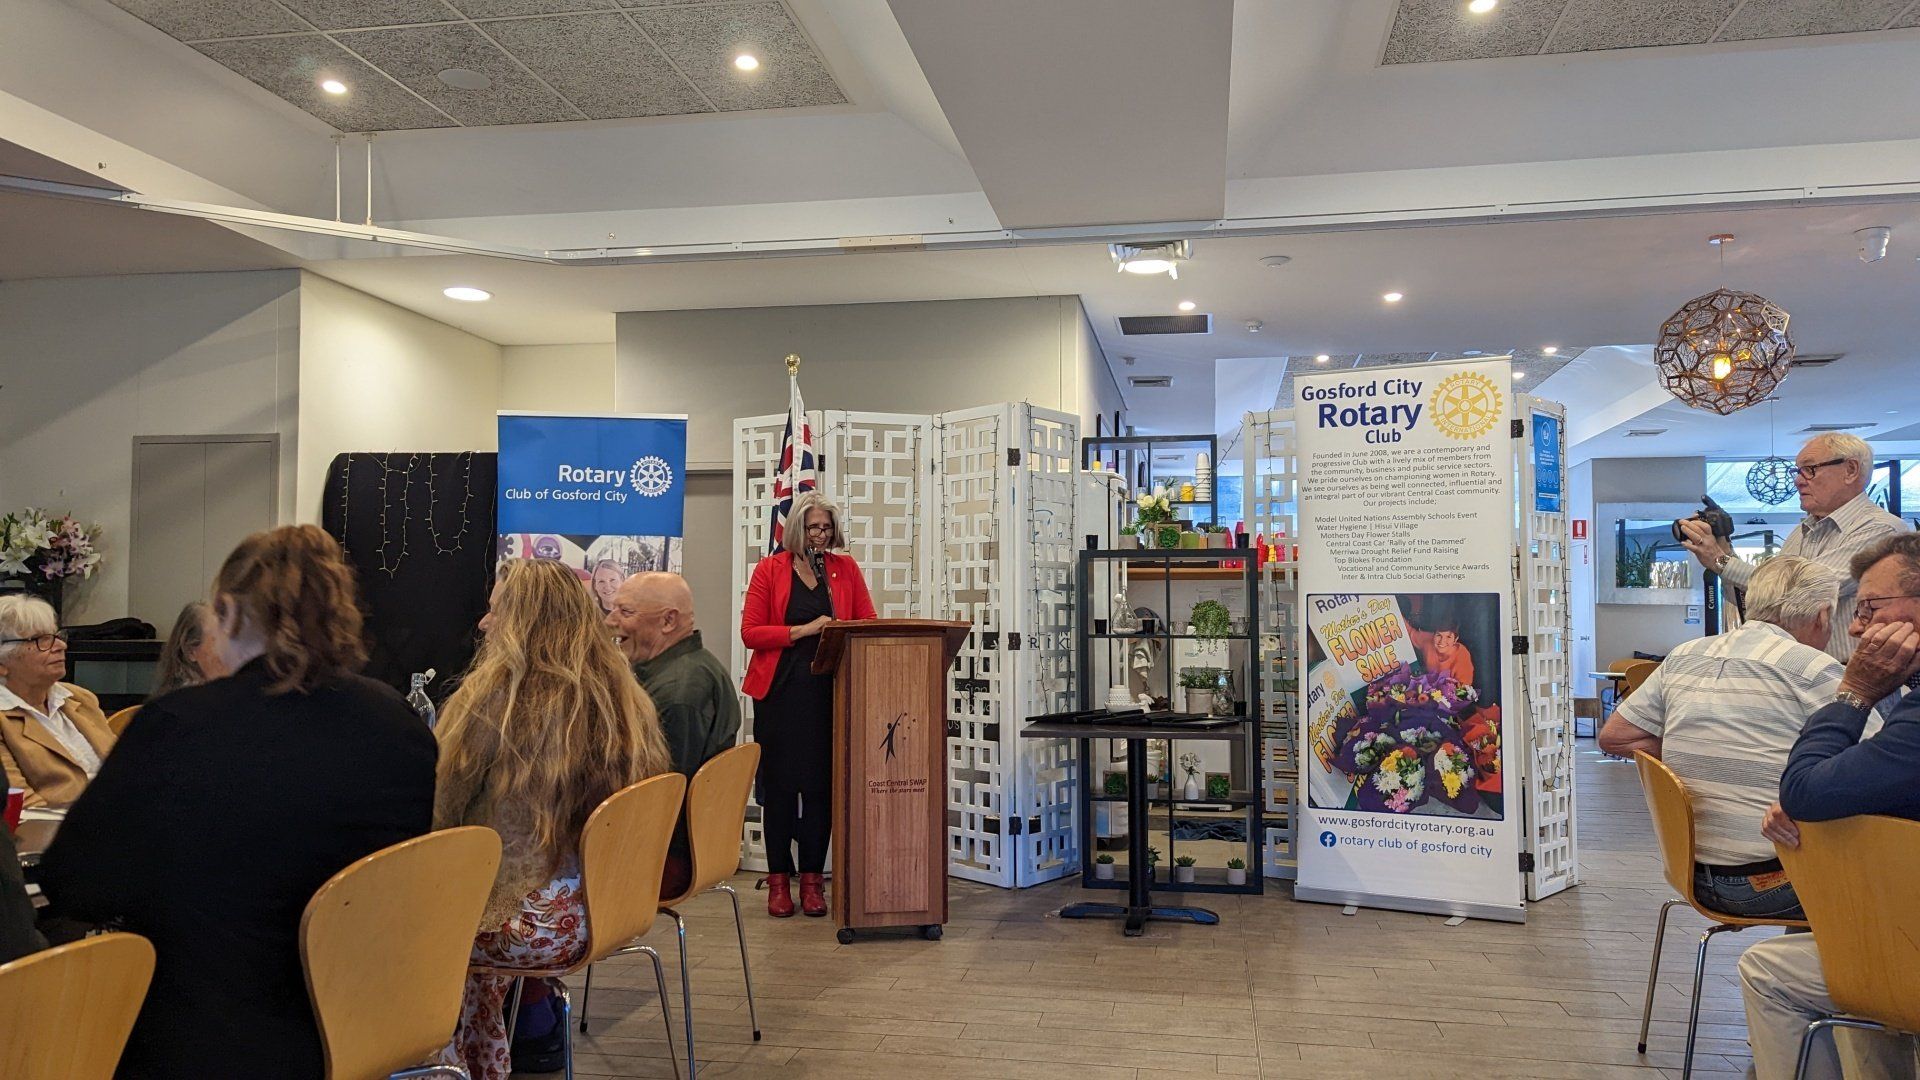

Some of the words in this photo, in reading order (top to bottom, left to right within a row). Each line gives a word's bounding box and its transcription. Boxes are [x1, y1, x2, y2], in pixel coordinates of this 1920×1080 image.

[1301, 380, 1376, 401] Gosford
[1384, 379, 1423, 398] City
[1450, 380, 1480, 388] ROTARY
[1318, 402, 1423, 431] Rotary
[1440, 415, 1492, 433] INTERNATIONAL
[1365, 429, 1402, 444] Club
[1424, 446, 1474, 454] contemporary
[1312, 460, 1350, 468] progressive
[1413, 464, 1434, 472] public
[559, 465, 626, 488] Rotary
[1385, 473, 1431, 481] championing
[1471, 470, 1497, 478] Rotary.
[1449, 479, 1486, 487] influential
[506, 489, 531, 499] Club
[535, 489, 549, 499] of
[553, 490, 600, 501] Gosford
[605, 491, 627, 504] City
[1315, 493, 1340, 501] integral
[1408, 489, 1433, 497] Central
[1457, 487, 1501, 495] community.
[1428, 512, 1456, 520] Schools
[1315, 594, 1360, 614] Rotary
[1320, 608, 1367, 639] Mother's
[1368, 598, 1391, 615] Day
[1328, 613, 1402, 666] FLOWER
[1356, 645, 1400, 683] SALE
[1308, 683, 1326, 708] tary
[910, 778, 927, 786] SWAP
[1318, 816, 1494, 837] www.gosfordcityrotary.org.au
[1340, 836, 1375, 849] rotary
[1378, 837, 1402, 849] club
[1406, 839, 1418, 850] of
[1421, 842, 1467, 854] gosford
[1470, 845, 1493, 858] city
